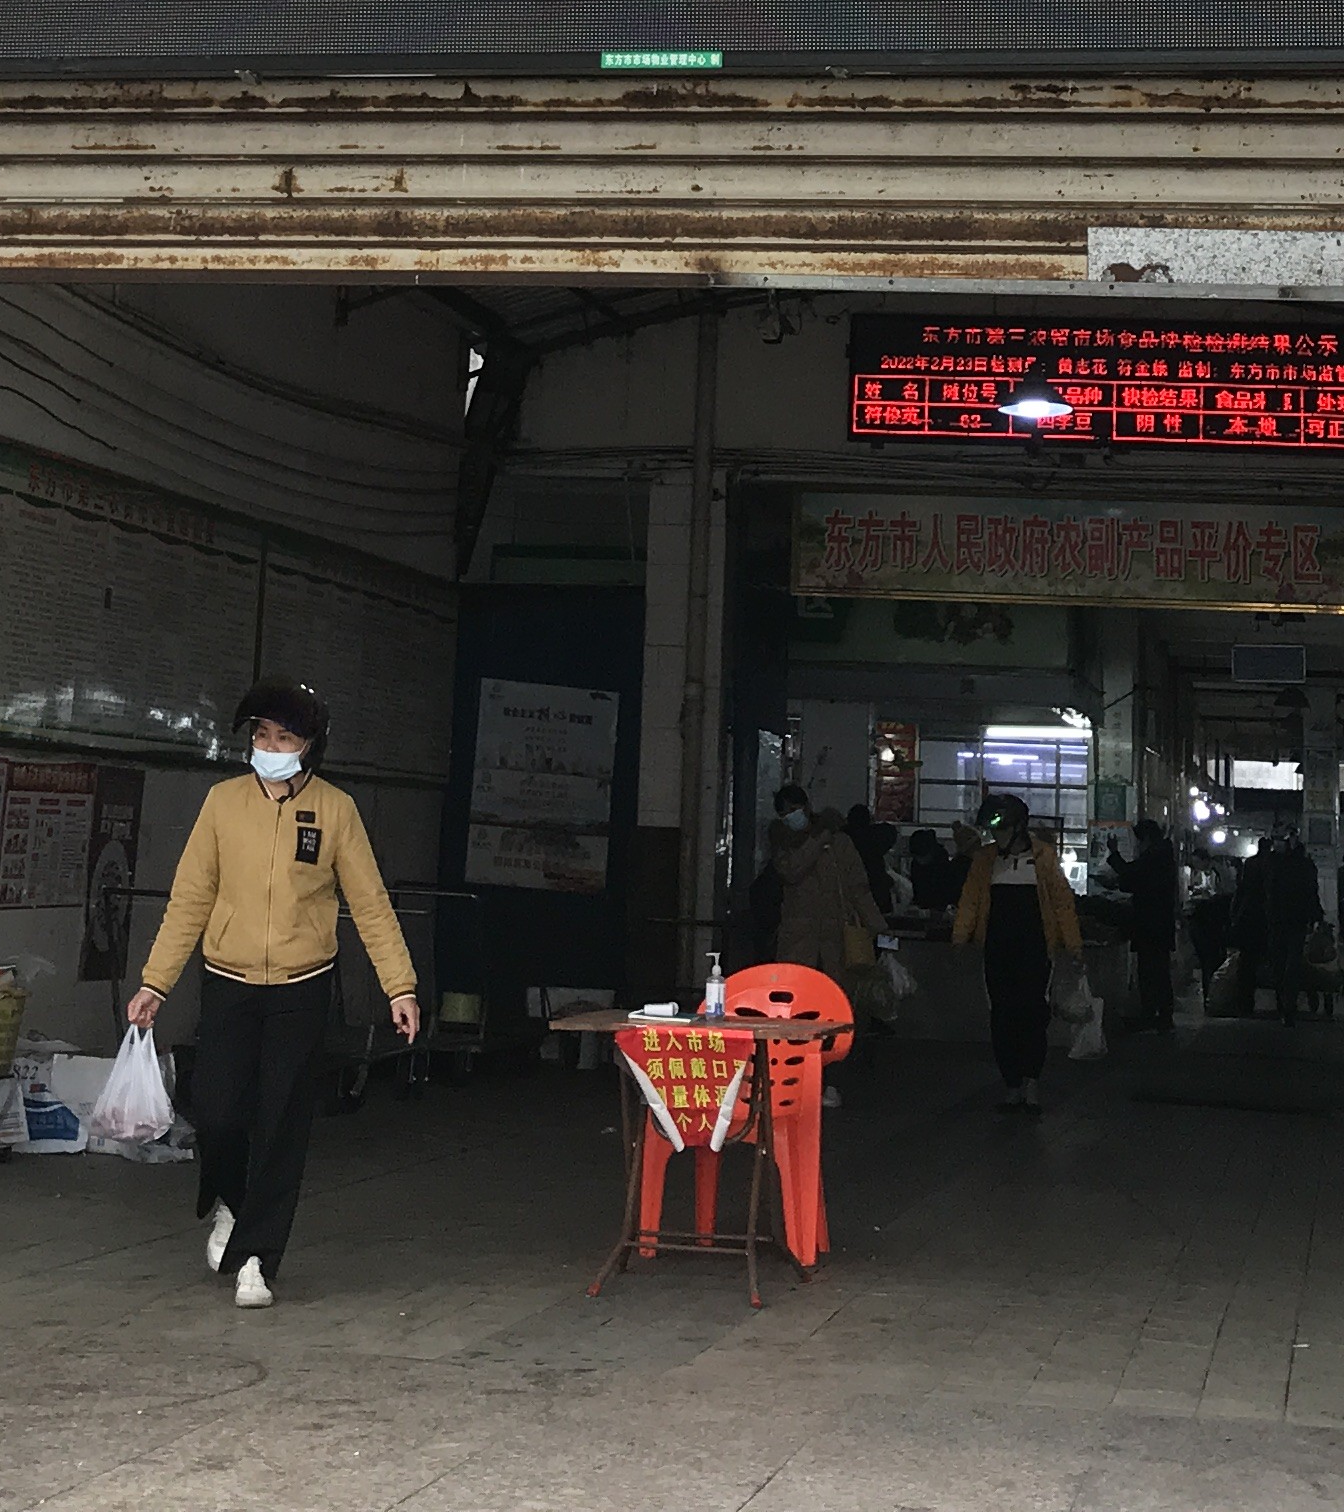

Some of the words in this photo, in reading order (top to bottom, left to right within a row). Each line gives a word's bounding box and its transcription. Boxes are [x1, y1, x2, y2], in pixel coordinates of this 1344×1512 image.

[1121, 387, 1199, 407] 快检结果
[823, 507, 1325, 586] 东方市人民政府农副产品平价专区
[642, 1028, 726, 1054] 进入市场
